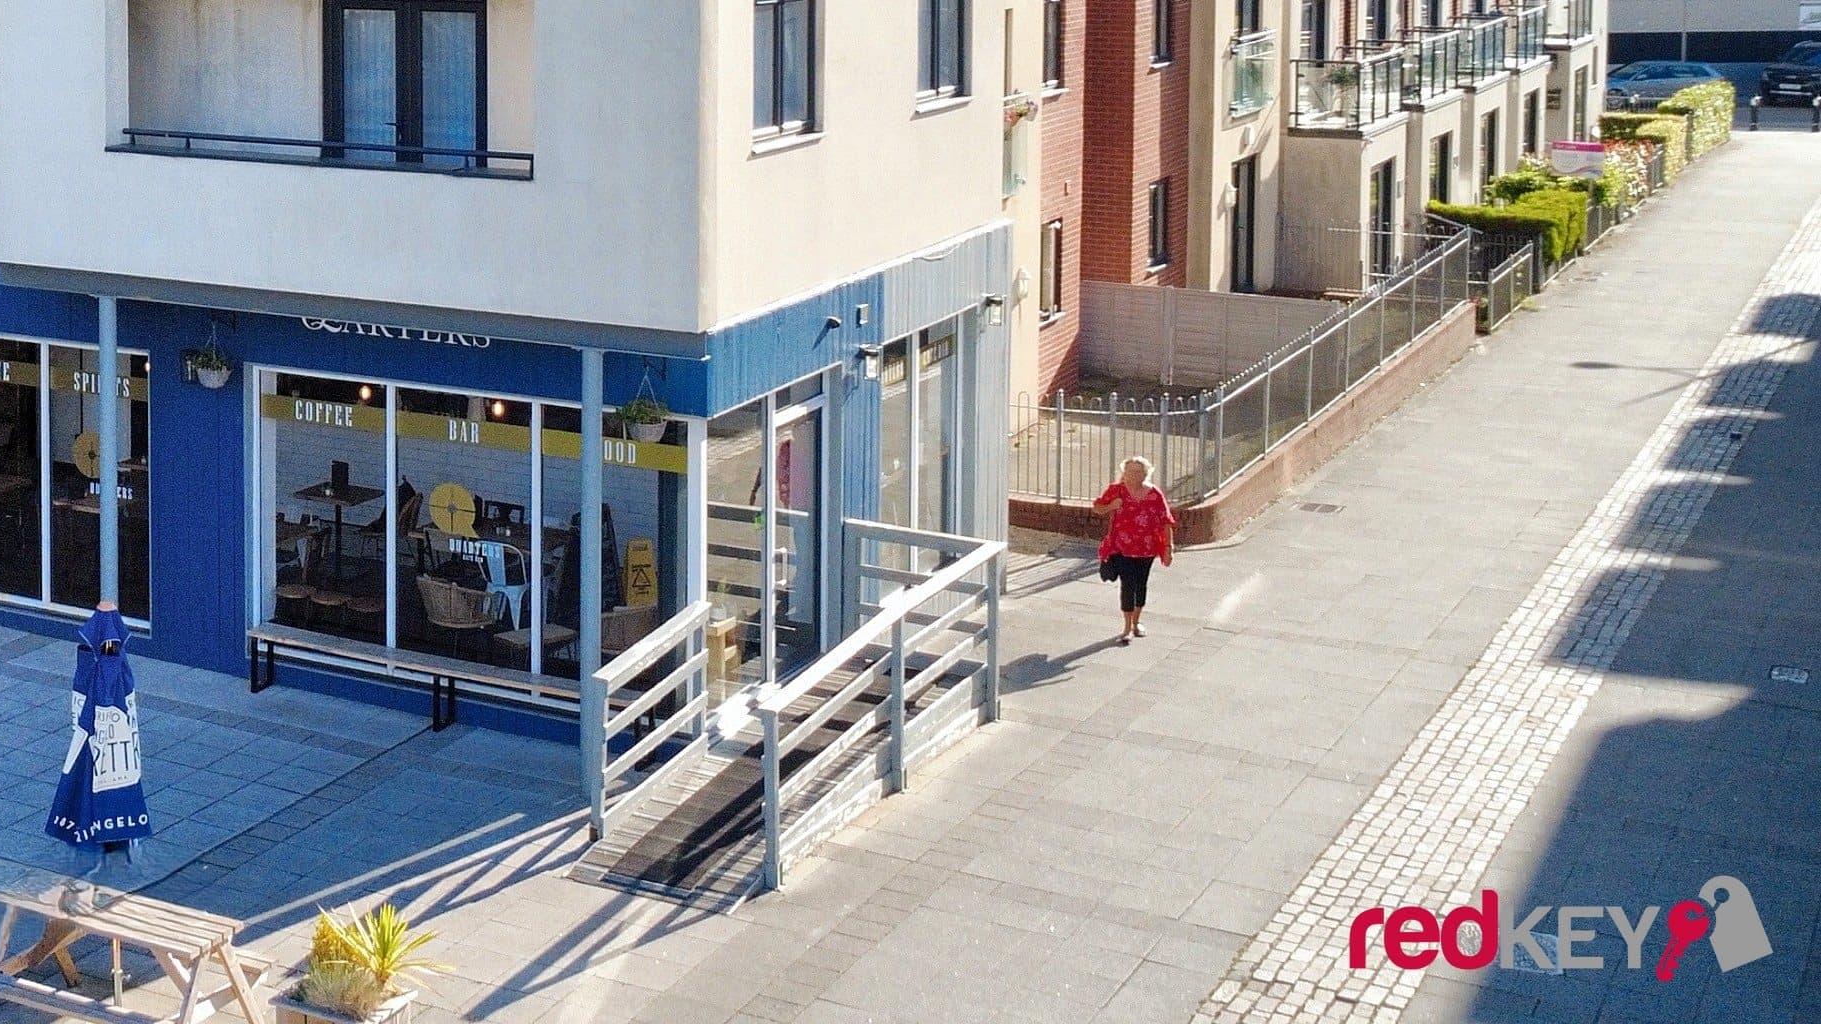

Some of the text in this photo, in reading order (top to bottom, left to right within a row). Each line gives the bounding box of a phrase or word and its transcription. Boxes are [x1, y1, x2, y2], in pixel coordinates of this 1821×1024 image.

[73, 371, 130, 398] SPITS
[295, 399, 353, 427] COFFEE
[448, 418, 479, 444] BAR
[604, 439, 636, 464] OOD
